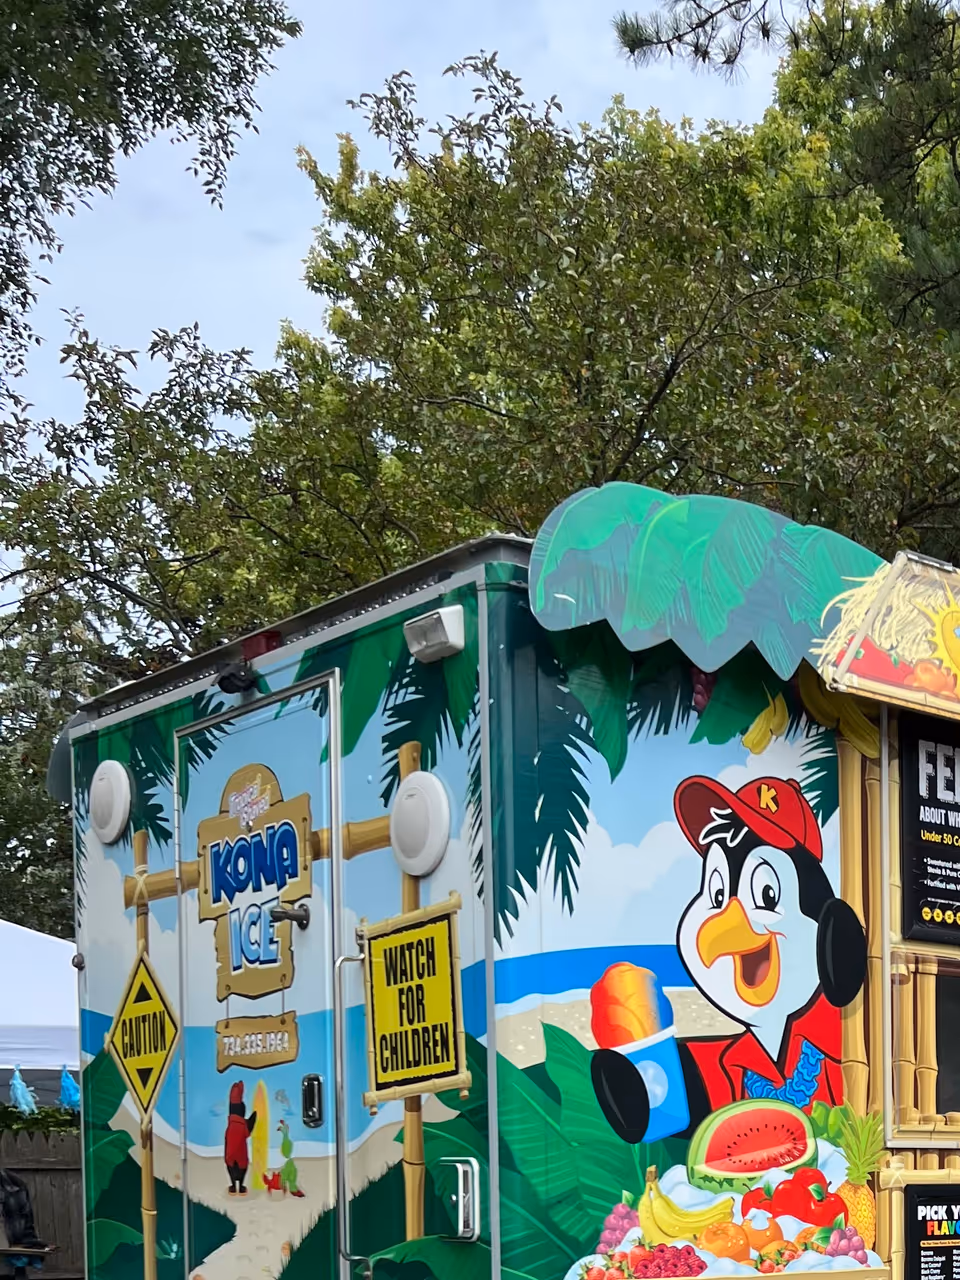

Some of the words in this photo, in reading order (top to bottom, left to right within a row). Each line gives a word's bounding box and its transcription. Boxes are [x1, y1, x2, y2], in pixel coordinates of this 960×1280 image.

[760, 783, 779, 814] K
[919, 806, 946, 825] ABOUT
[921, 829, 942, 843] Under
[943, 834, 952, 844] 50
[209, 820, 299, 904] KONA
[942, 868, 946, 876] &
[947, 870, 957, 878] Pure
[946, 882, 956, 890] with
[228, 897, 282, 976] ICE
[383, 936, 436, 987] WATCH
[398, 983, 425, 1028] FOR
[121, 1010, 167, 1060] CAUTION
[379, 1025, 451, 1075] CHILDREN
[917, 1205, 947, 1221] PICK
